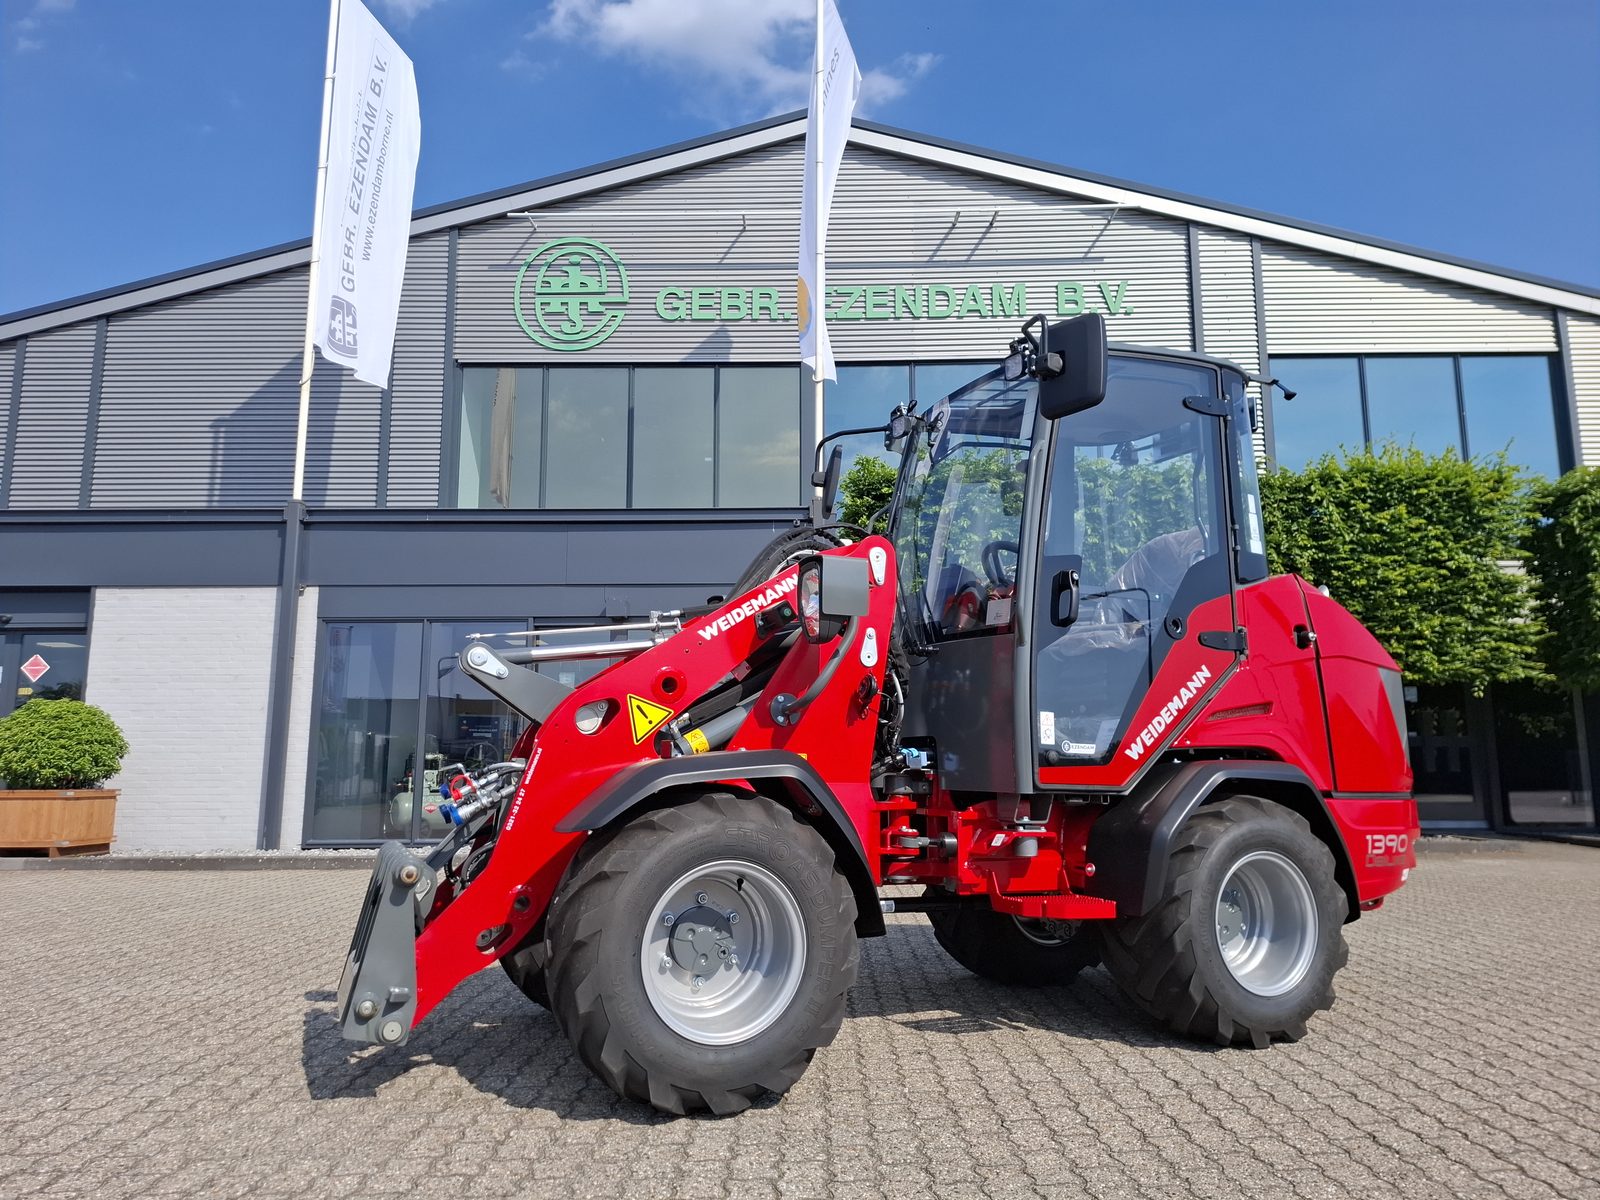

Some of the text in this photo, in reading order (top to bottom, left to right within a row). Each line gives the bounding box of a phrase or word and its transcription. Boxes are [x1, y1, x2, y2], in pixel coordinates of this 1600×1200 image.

[371, 55, 388, 99] B.V.
[349, 100, 378, 213] EZENDAM
[341, 222, 358, 293] GEBR.
[656, 287, 794, 321] GEBR.
[1056, 281, 1134, 315] B.V.
[697, 573, 799, 640] WEIDEMANN
[1124, 664, 1212, 761] WEIDEMANN
[1366, 834, 1408, 854] 1390
